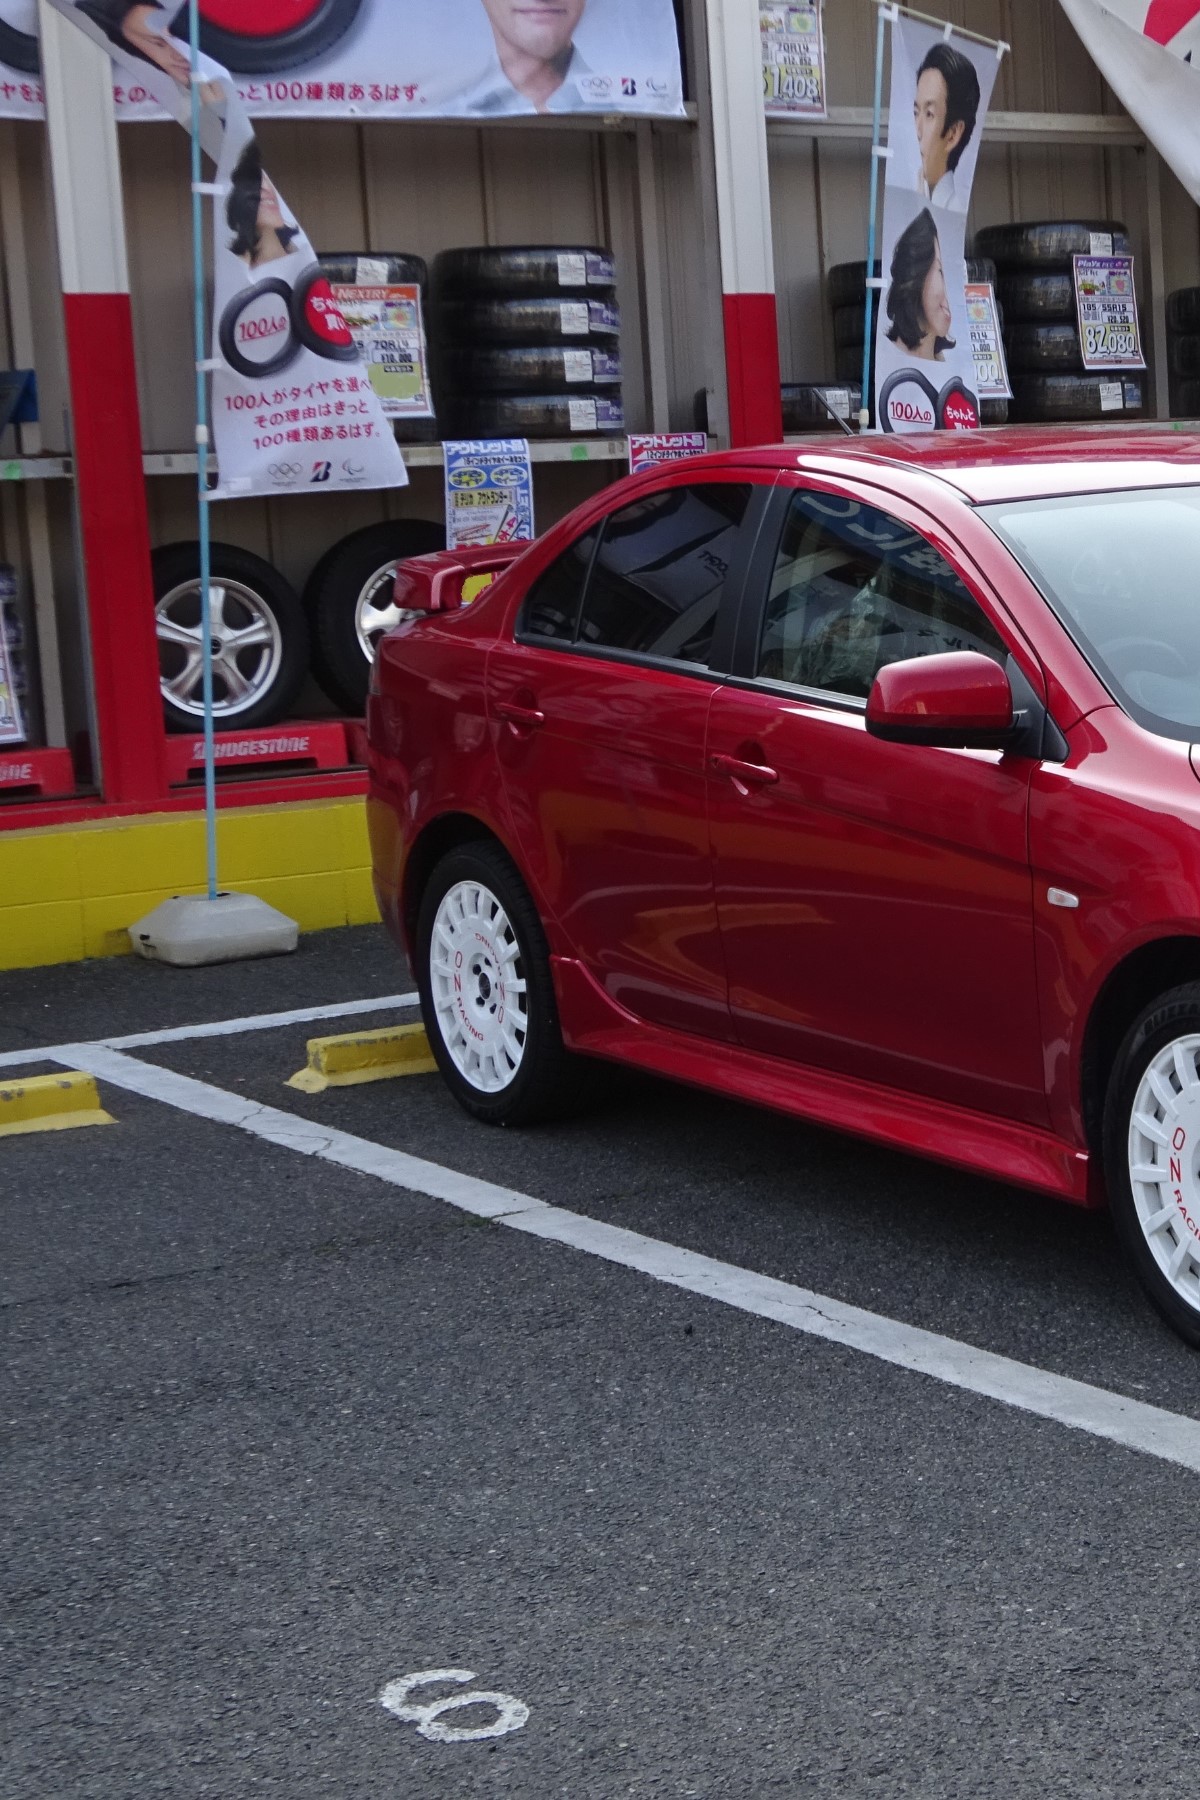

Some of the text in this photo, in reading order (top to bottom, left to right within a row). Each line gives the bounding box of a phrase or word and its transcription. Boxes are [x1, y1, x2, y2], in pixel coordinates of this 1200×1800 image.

[254, 400, 369, 428] その理由はきっと
[890, 401, 932, 422] 100人の
[252, 422, 380, 450] 100種類あるはず。
[631, 434, 704, 449] アウトレット品
